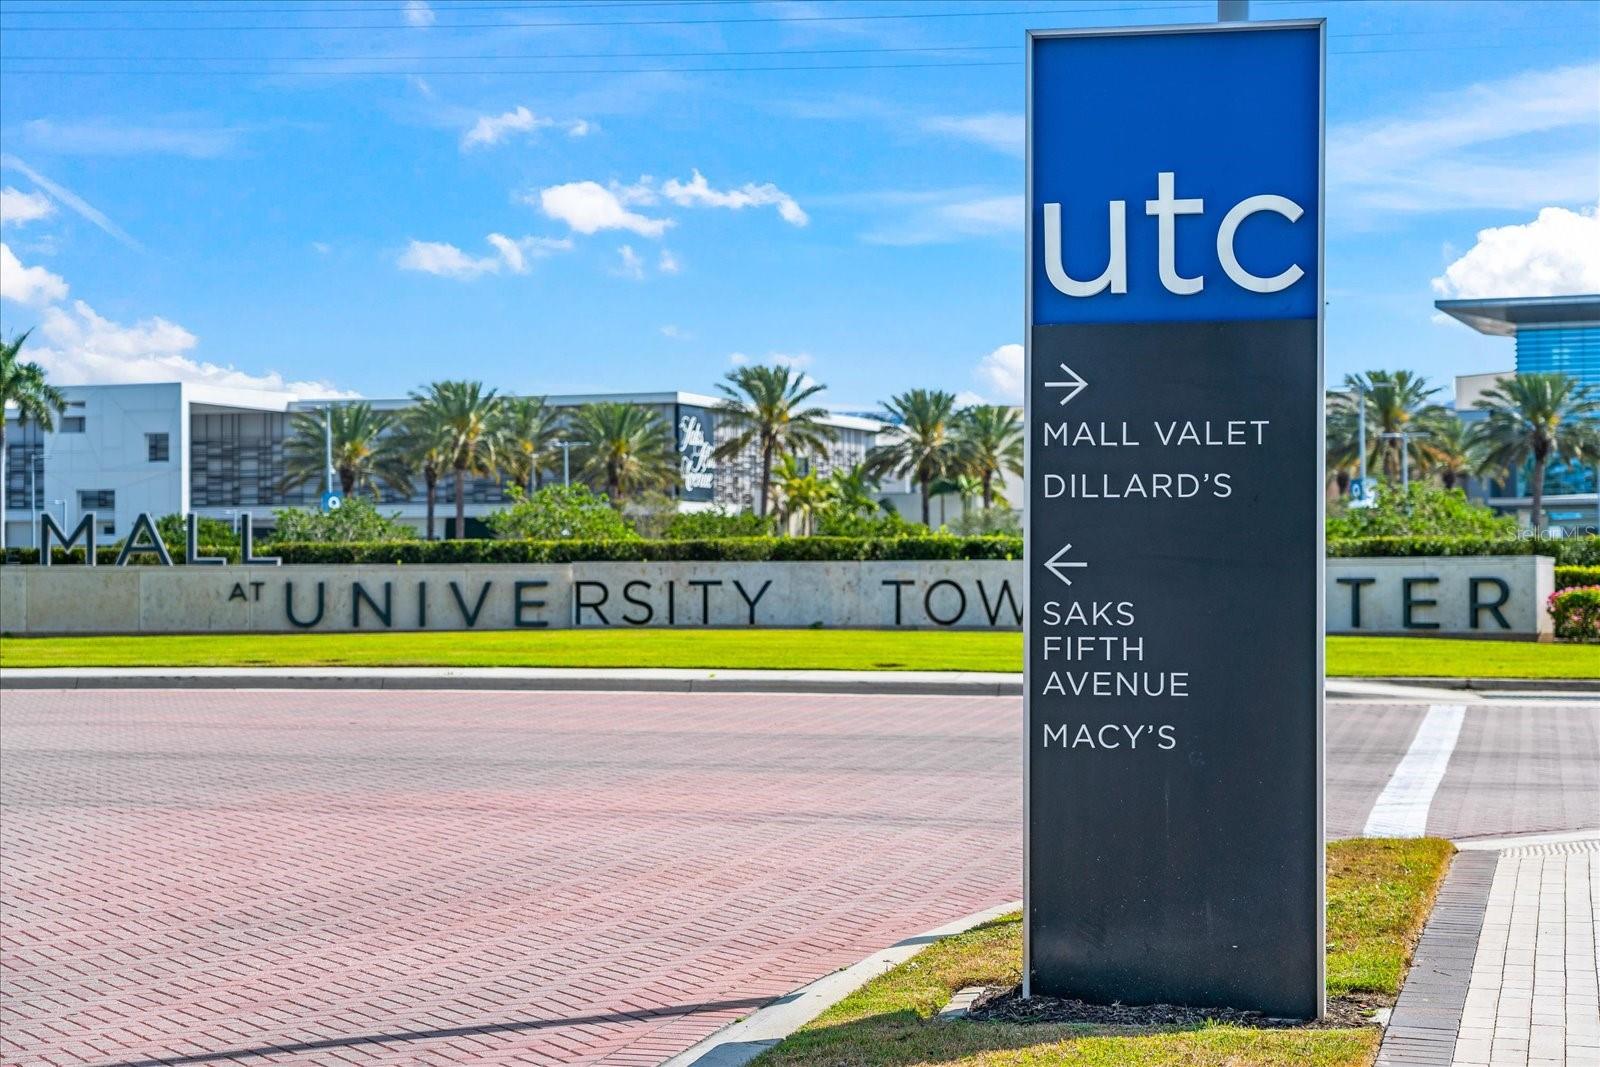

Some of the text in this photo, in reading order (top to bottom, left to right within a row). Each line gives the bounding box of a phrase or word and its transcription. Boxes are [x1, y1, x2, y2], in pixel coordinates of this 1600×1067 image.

[1043, 171, 1305, 297] utc
[1043, 419, 1270, 447] MALL VALET
[1043, 472, 1233, 499] DILLARD’S
[40, 510, 282, 567] MALL
[227, 576, 1512, 630] AT UNIVERSITY TOW TER
[1042, 601, 1136, 627] SAKS
[1043, 636, 1145, 662] FIFTH
[1042, 671, 1189, 697] AVENUE
[1043, 723, 1177, 750] MACY’S
